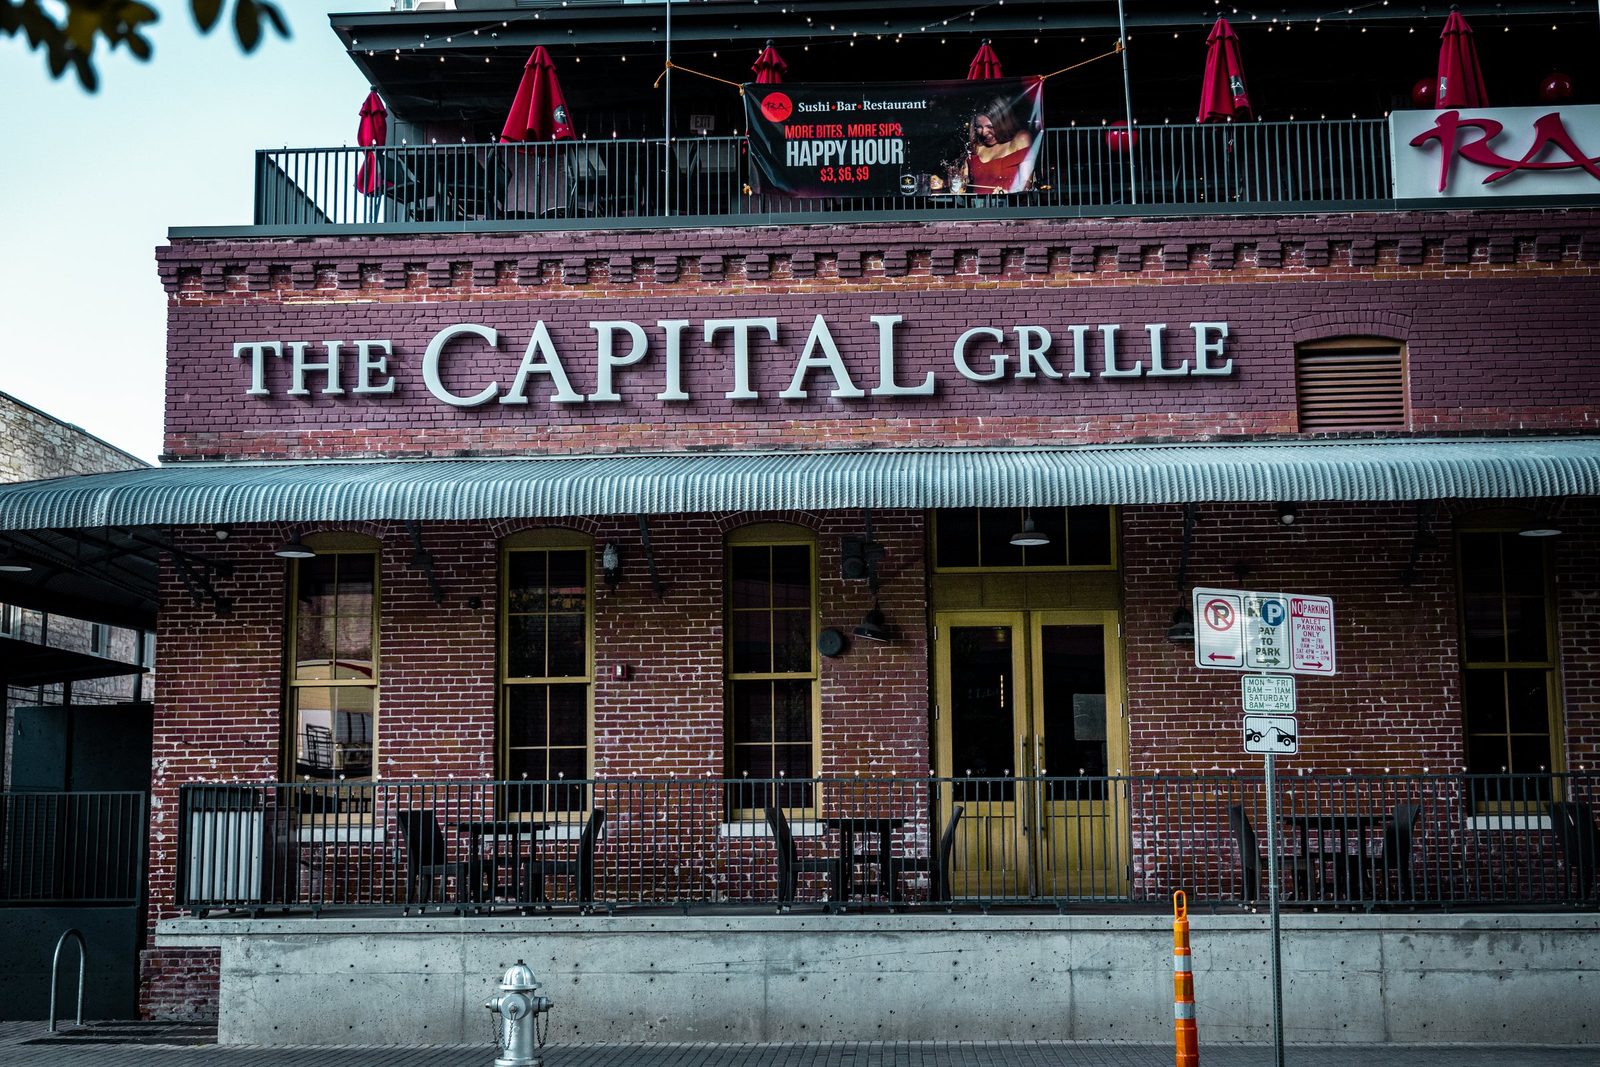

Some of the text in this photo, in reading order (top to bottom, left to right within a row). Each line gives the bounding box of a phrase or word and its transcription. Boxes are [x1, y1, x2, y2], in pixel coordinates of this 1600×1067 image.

[798, 99, 927, 112] Sushi Bar Restaurant
[694, 115, 711, 129] EXIT
[784, 122, 904, 139] MORE BITES. MORE SIPS.
[786, 138, 904, 167] HAPPY HOUR
[1409, 110, 1600, 193] RA
[856, 166, 869, 181] $9
[233, 314, 1233, 407] THE CAPITAL GRILLE
[1291, 600, 1329, 615] NO PARKING
[1258, 627, 1276, 635] PAY
[1296, 624, 1326, 632] PARKING
[1261, 637, 1274, 646] TO
[1255, 647, 1281, 656] PARK
[1249, 694, 1289, 702] SATURDAY
